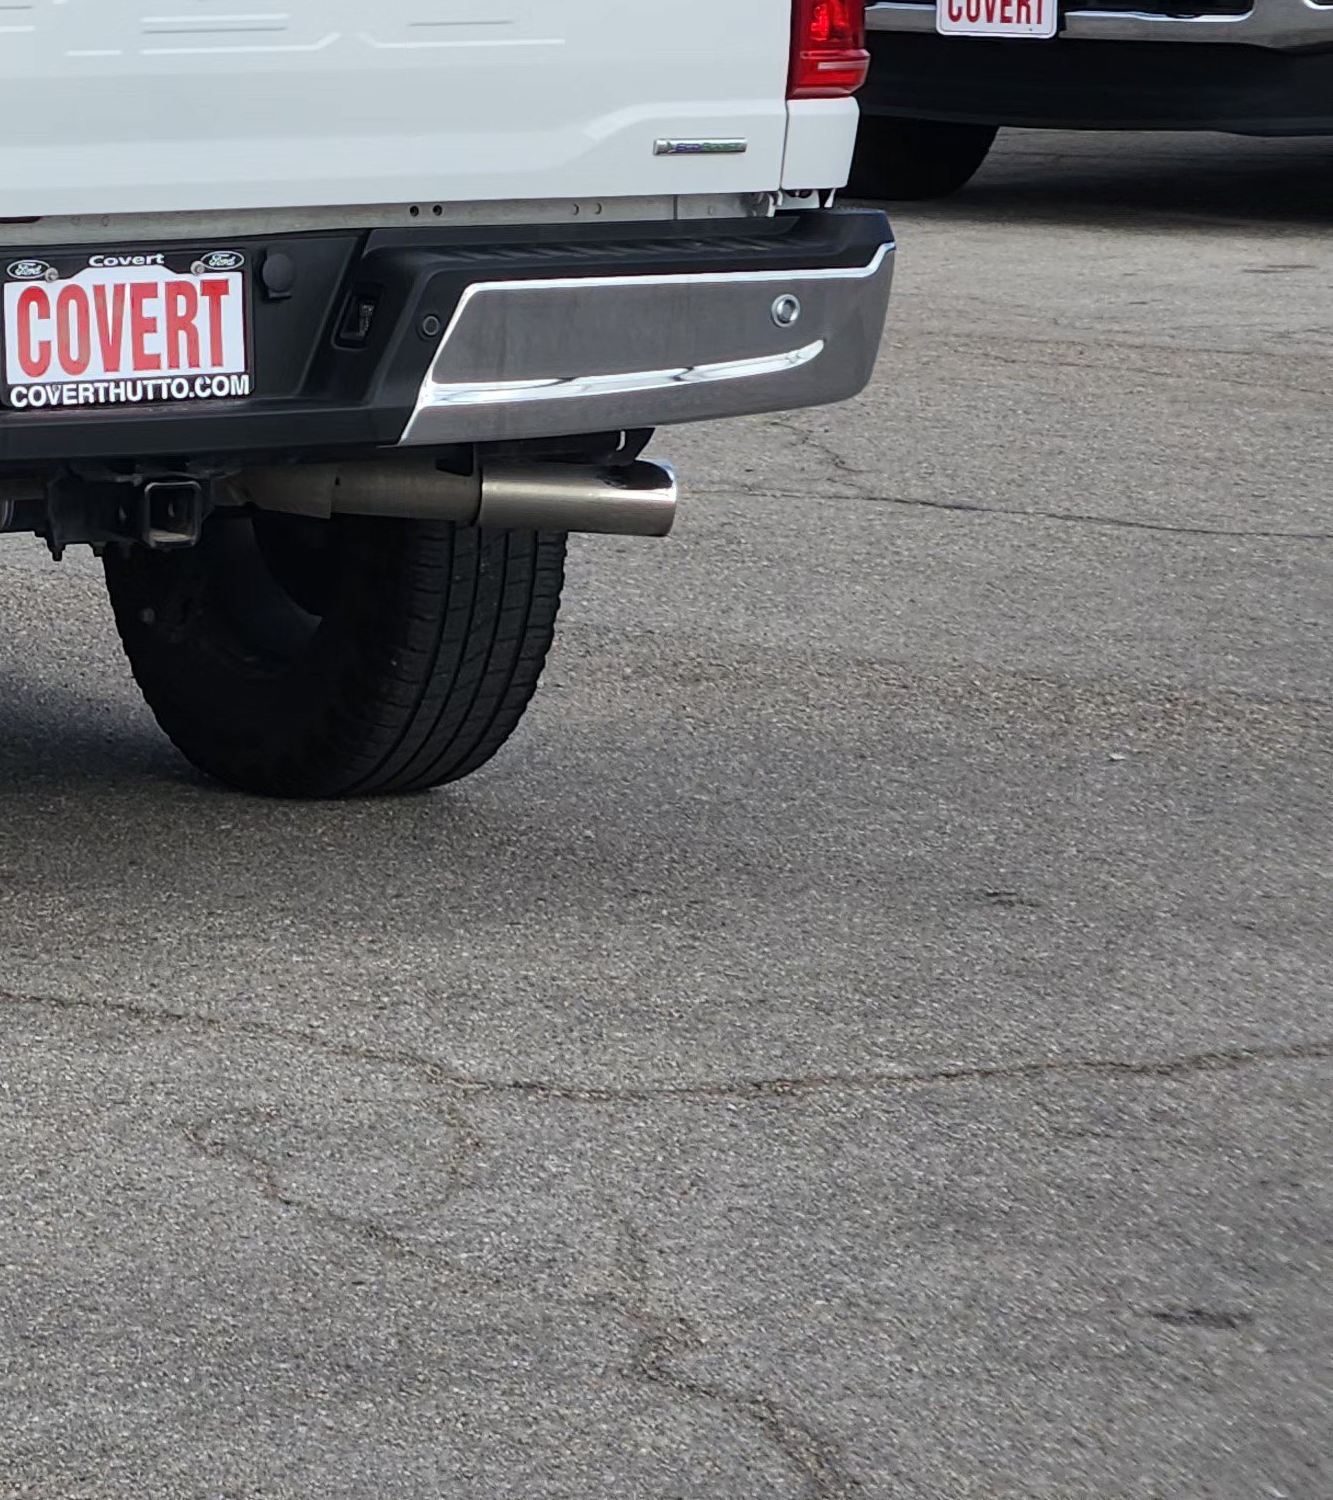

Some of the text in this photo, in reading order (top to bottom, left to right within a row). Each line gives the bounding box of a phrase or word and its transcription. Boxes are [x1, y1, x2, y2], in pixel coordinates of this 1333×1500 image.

[88, 253, 165, 268] Covert
[16, 278, 230, 379] COVERT
[9, 373, 251, 409] COVERTHUTTO.COM
